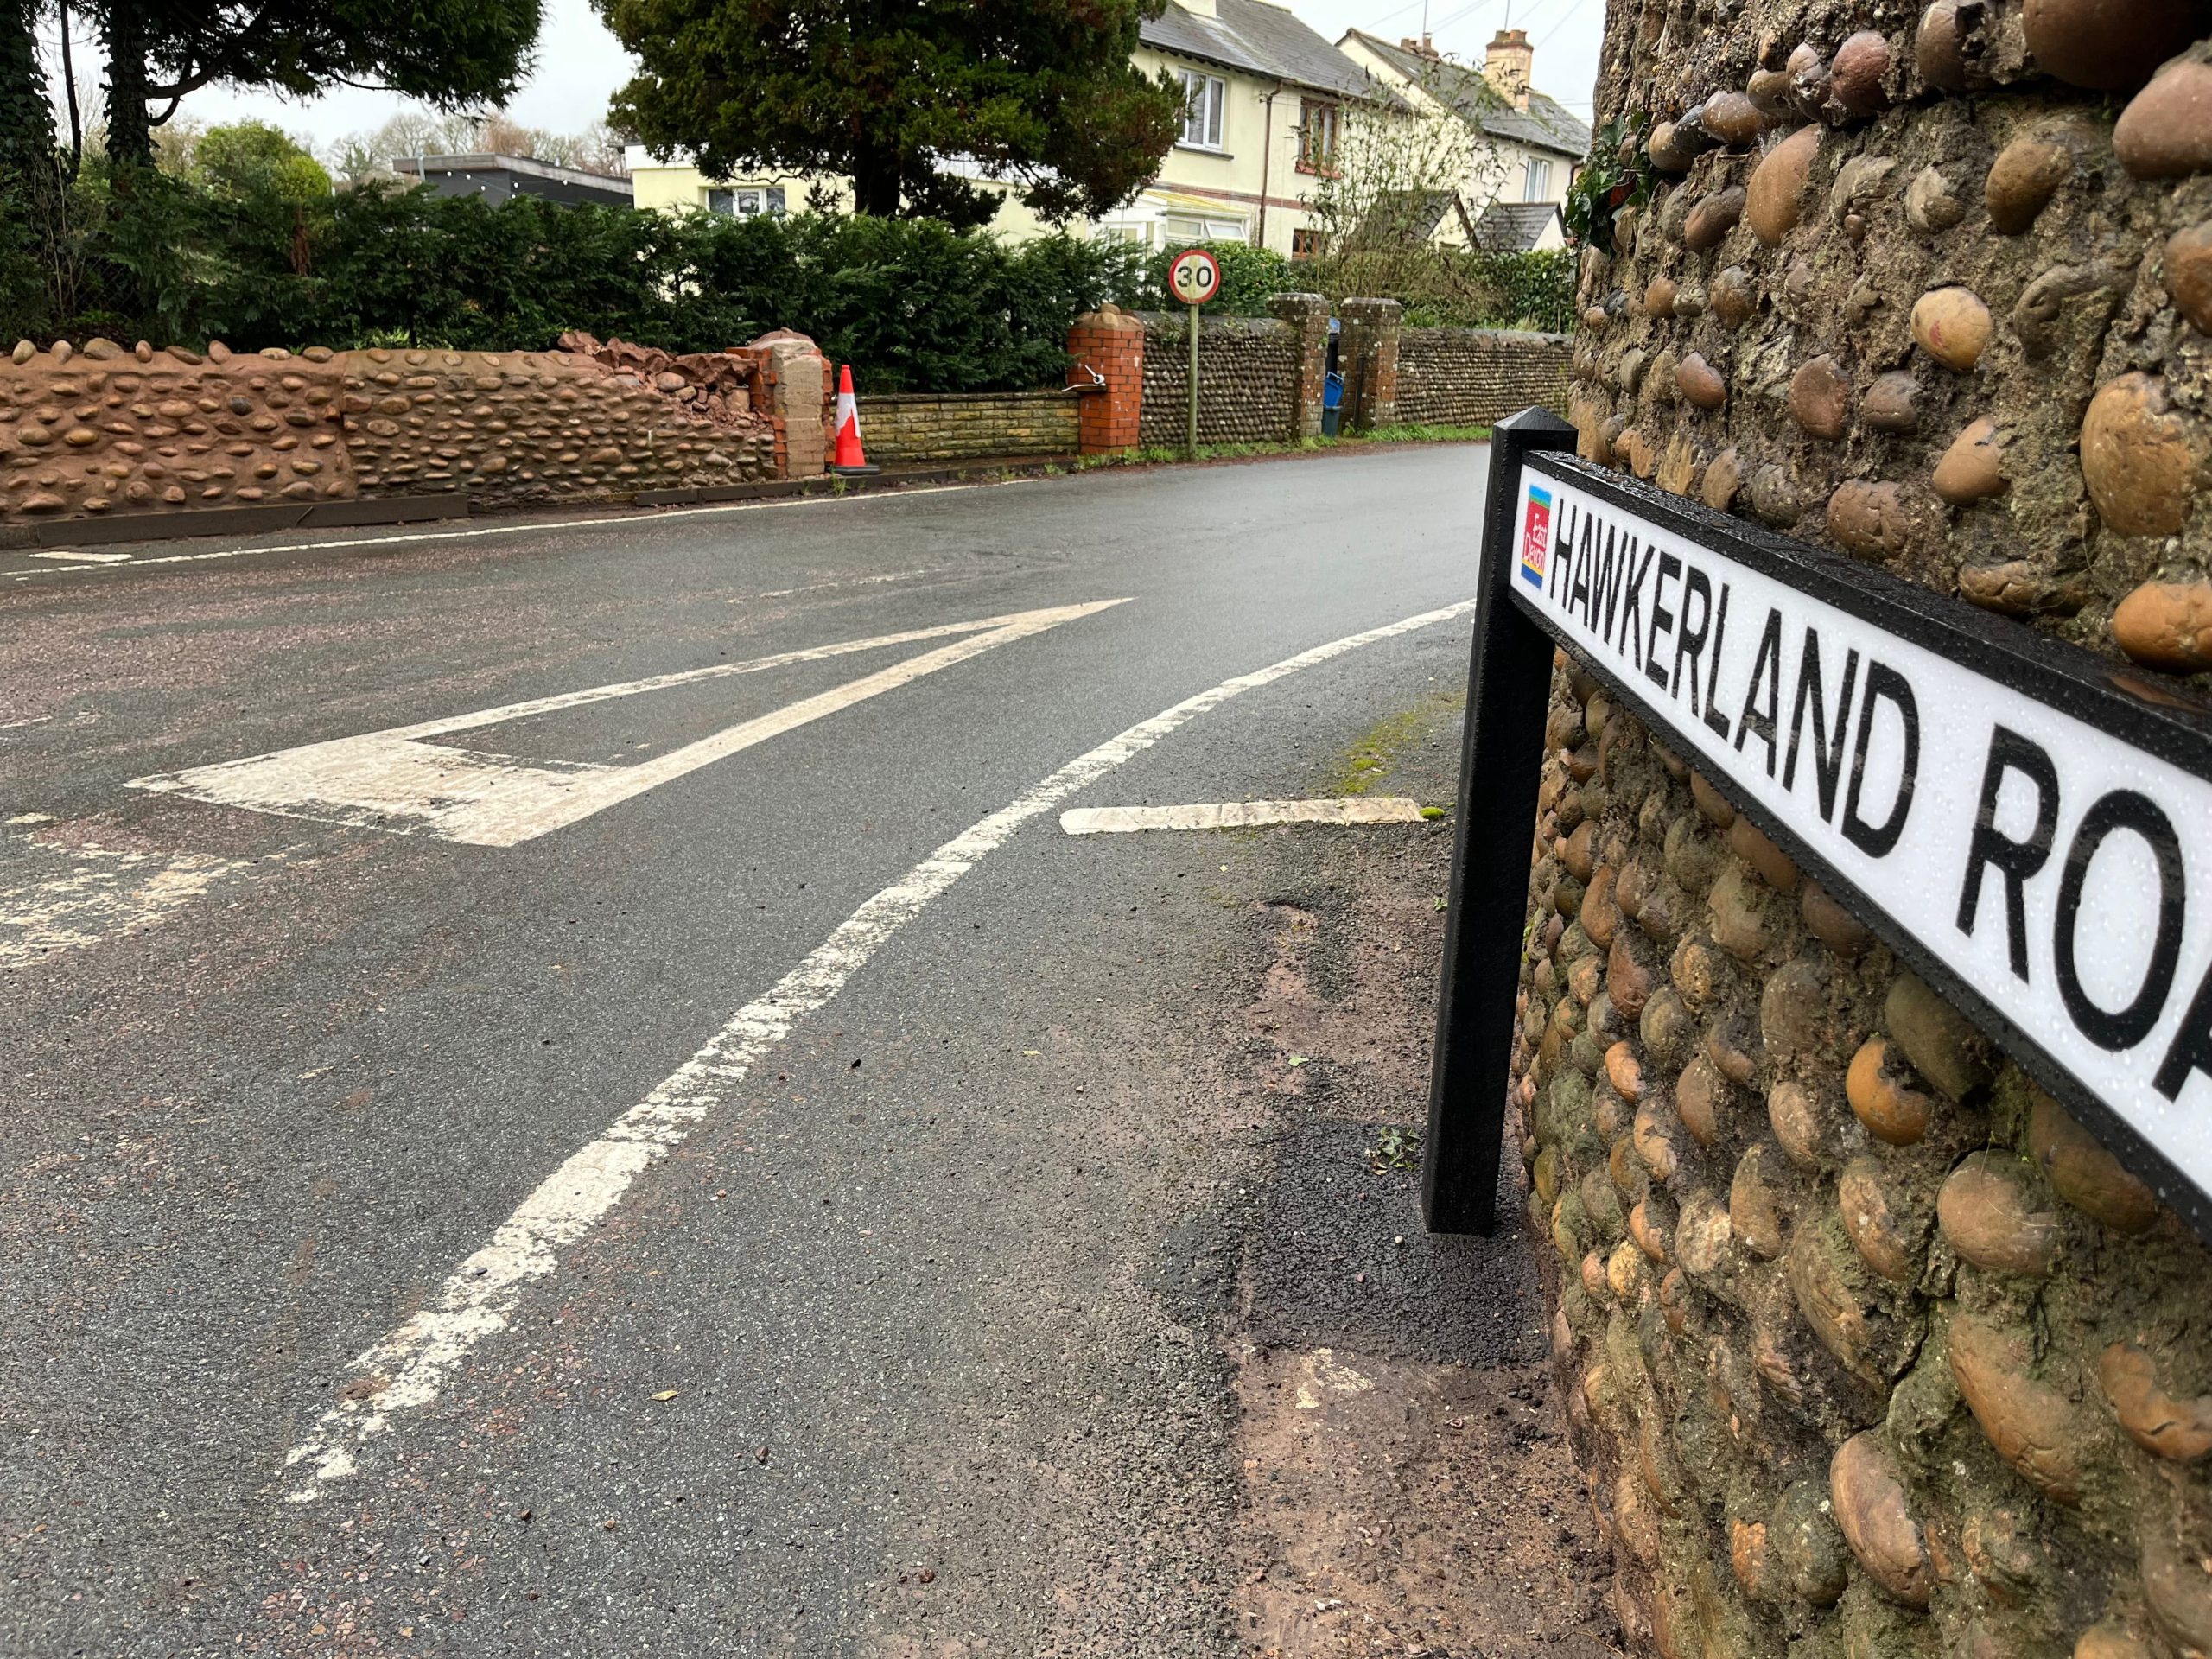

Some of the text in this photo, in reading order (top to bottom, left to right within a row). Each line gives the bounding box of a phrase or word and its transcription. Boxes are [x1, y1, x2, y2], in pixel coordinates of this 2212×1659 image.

[1177, 266, 1212, 288] 30
[1532, 512, 1548, 549] East
[1523, 531, 1547, 571] Devon
[1549, 498, 1920, 859] HAWKERLAND
